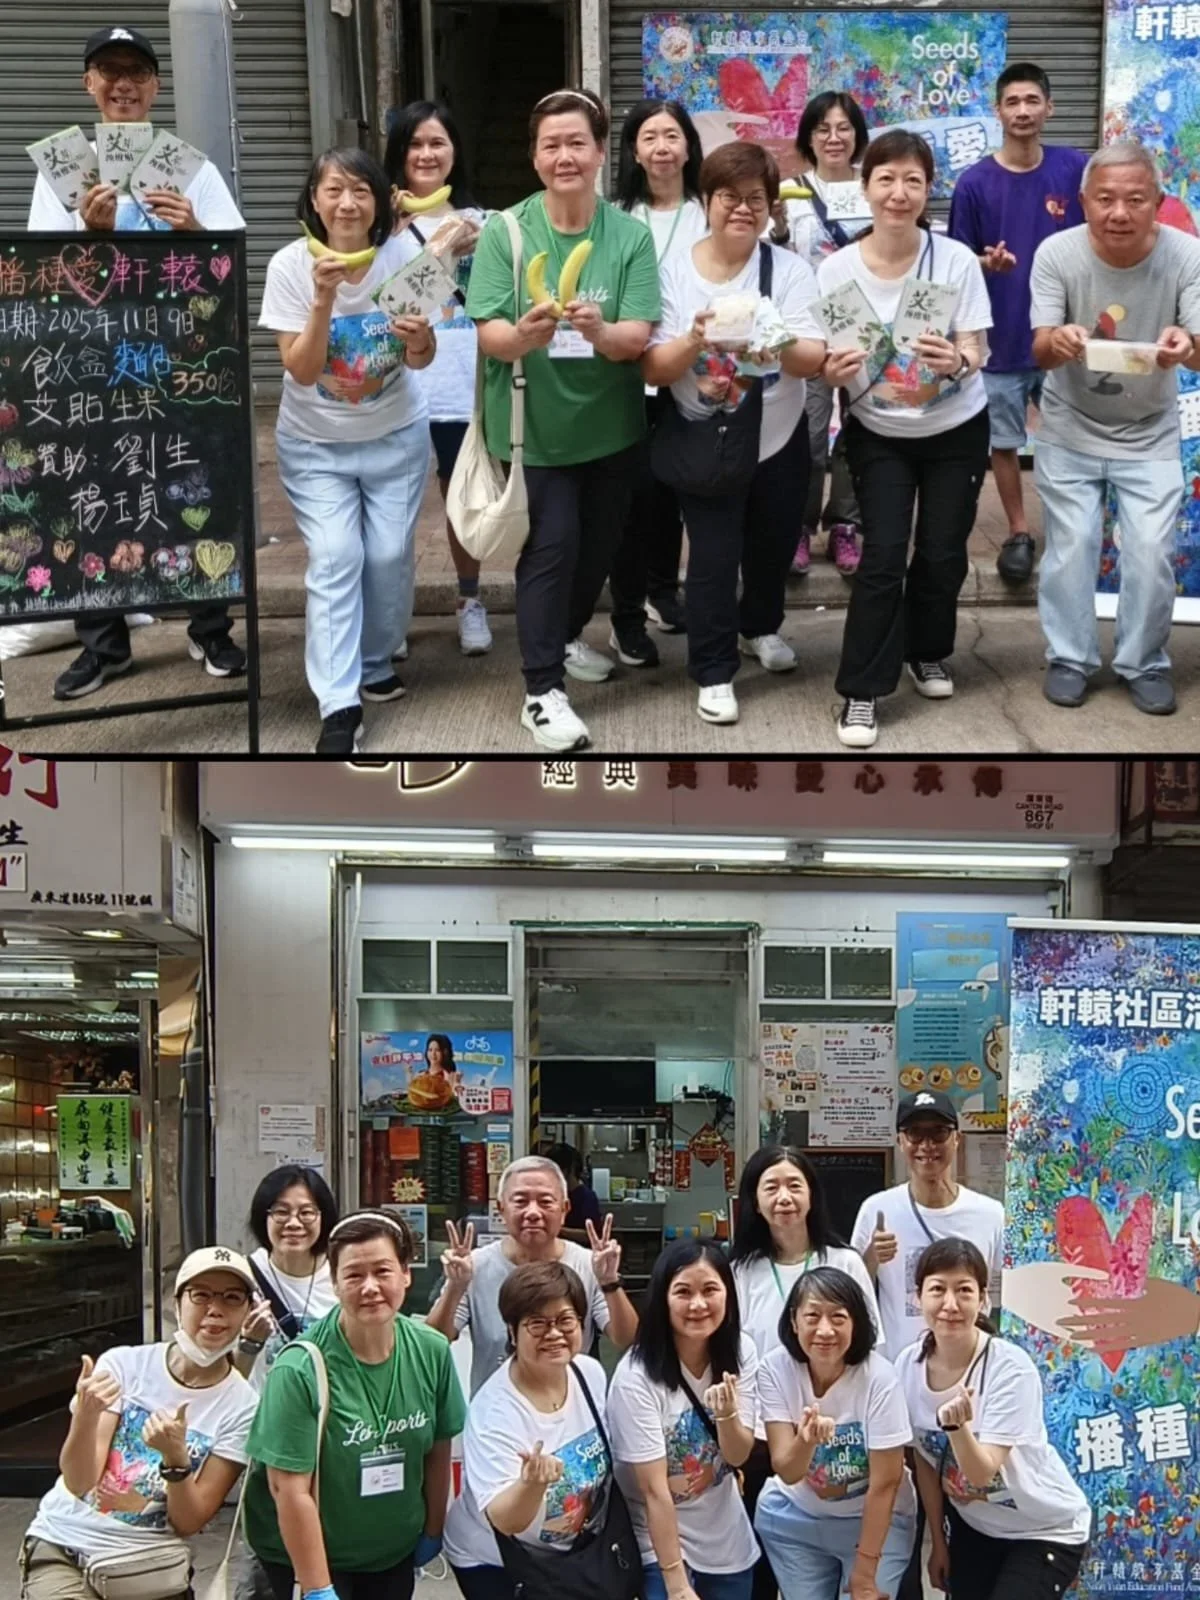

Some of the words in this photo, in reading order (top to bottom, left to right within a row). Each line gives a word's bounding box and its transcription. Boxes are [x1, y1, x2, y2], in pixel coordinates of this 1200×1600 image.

[911, 31, 980, 60] Seeds
[933, 60, 957, 86] of
[917, 81, 970, 105] Love
[945, 123, 987, 171] 愛
[23, 389, 166, 428] 艾貼生果
[111, 431, 200, 480] 劉生
[1025, 810, 1054, 822] 867
[825, 1426, 862, 1449] Seeds
[1074, 1403, 1191, 1474] 播種
[838, 1445, 850, 1463] of
